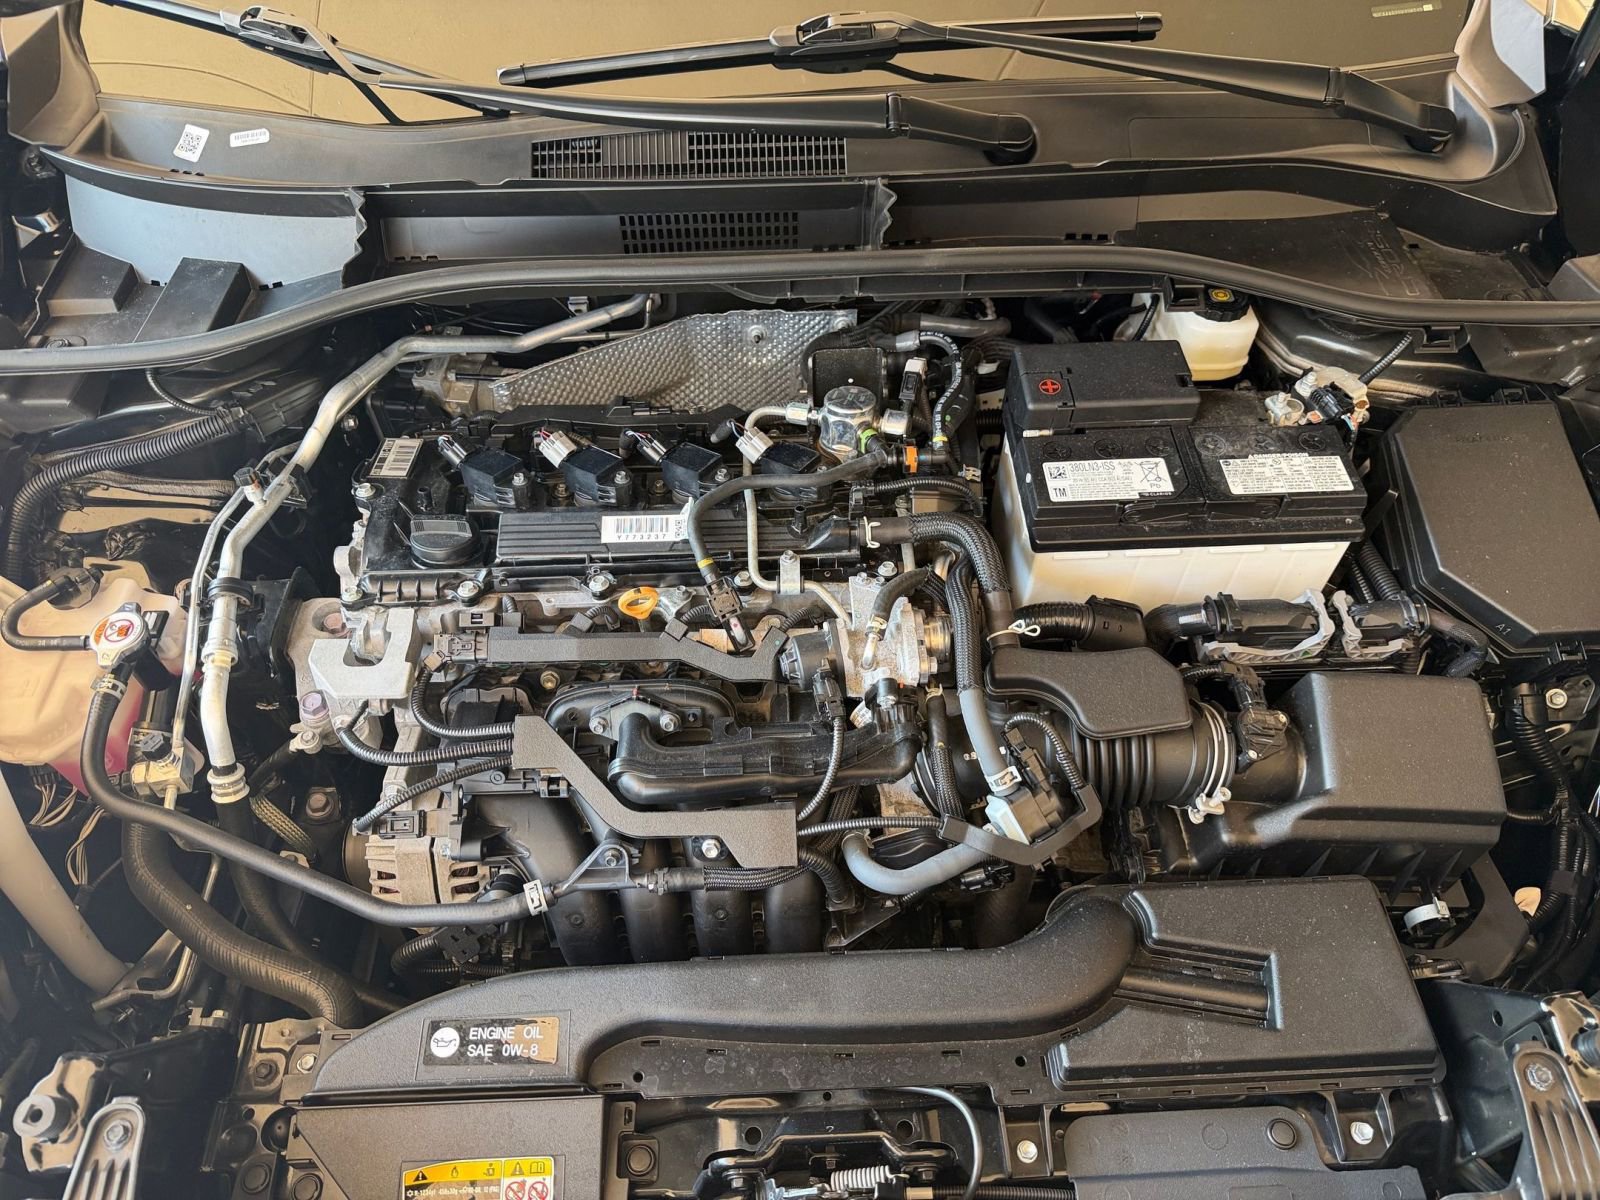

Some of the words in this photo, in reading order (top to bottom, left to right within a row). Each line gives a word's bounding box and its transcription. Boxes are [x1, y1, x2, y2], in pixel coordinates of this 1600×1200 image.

[1069, 461, 1116, 472] 380LN3-ISS
[1053, 488, 1067, 497] TM
[469, 1026, 515, 1040] ENGINE
[523, 1026, 544, 1039] OIL
[467, 1044, 494, 1057] SAE
[502, 1043, 539, 1056] 0W-8
